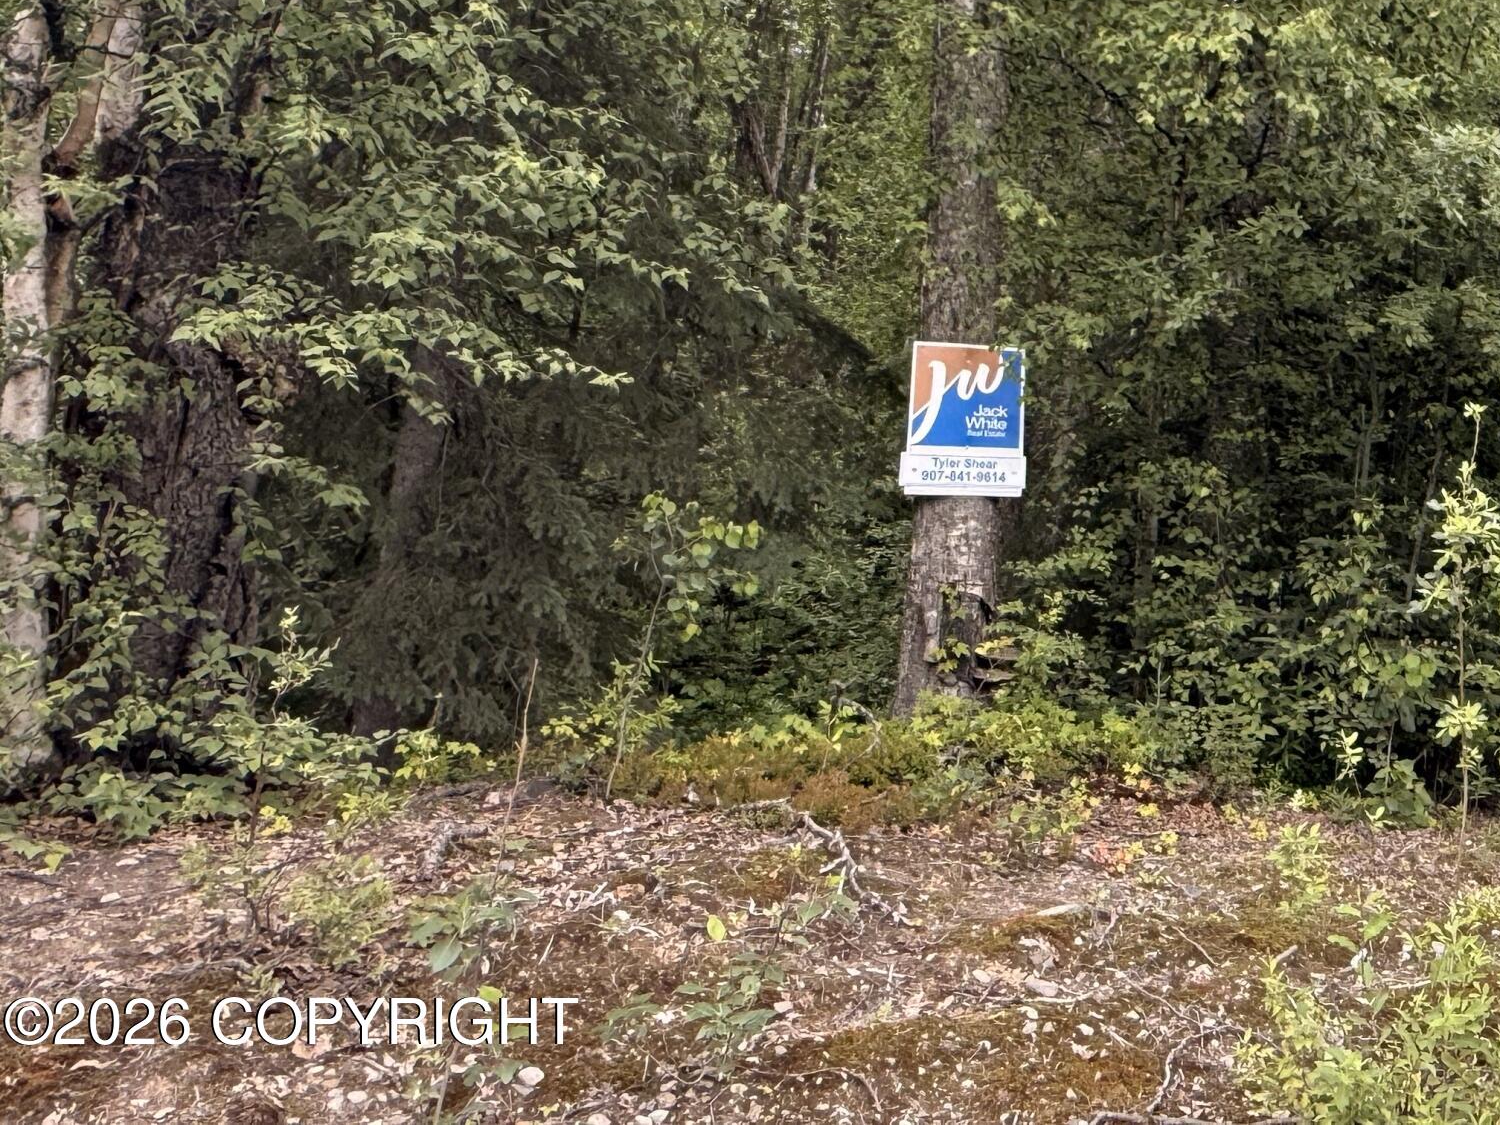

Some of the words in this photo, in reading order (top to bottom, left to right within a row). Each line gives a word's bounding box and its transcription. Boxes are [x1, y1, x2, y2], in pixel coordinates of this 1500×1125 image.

[973, 403, 1008, 418] Jack
[965, 416, 1008, 430] White
[931, 457, 961, 470] Tyler
[963, 458, 998, 469] Shear
